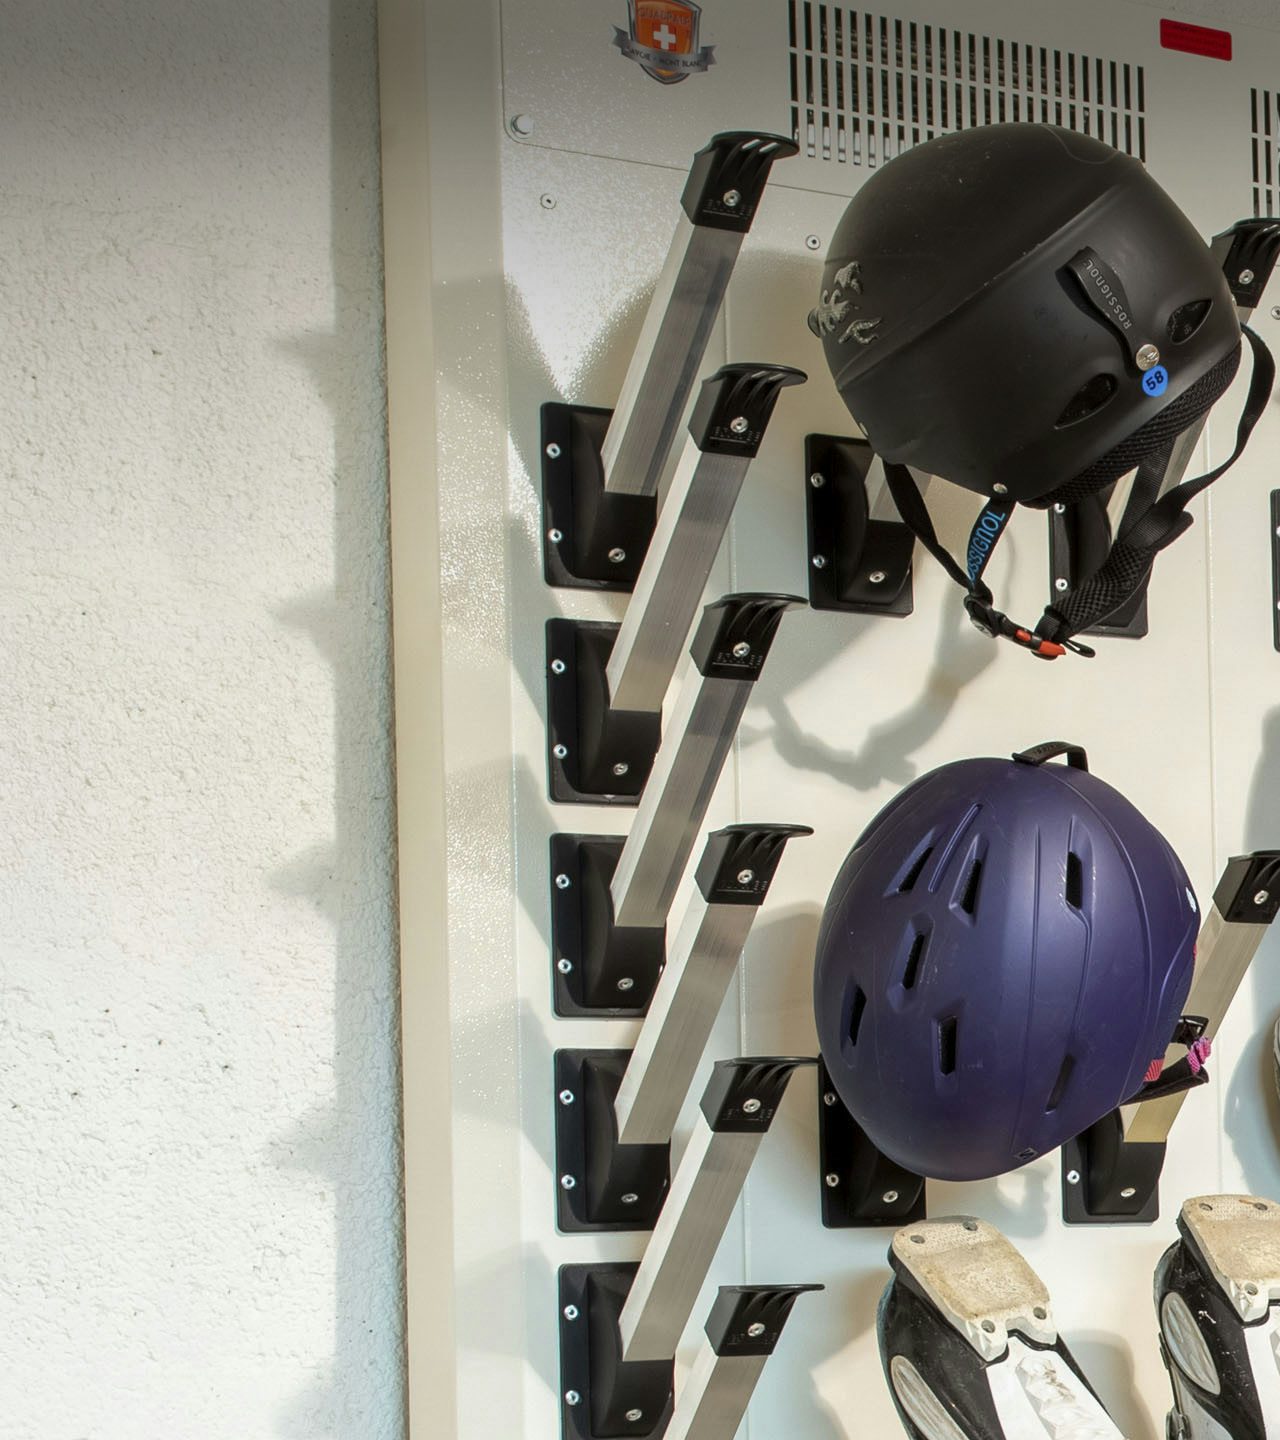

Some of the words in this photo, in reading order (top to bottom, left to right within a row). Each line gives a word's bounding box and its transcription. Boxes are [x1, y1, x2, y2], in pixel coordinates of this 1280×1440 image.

[1086, 259, 1132, 330] ROSSIGNOL
[1145, 370, 1164, 390] 58
[967, 510, 1006, 582] OSSIGNOL
